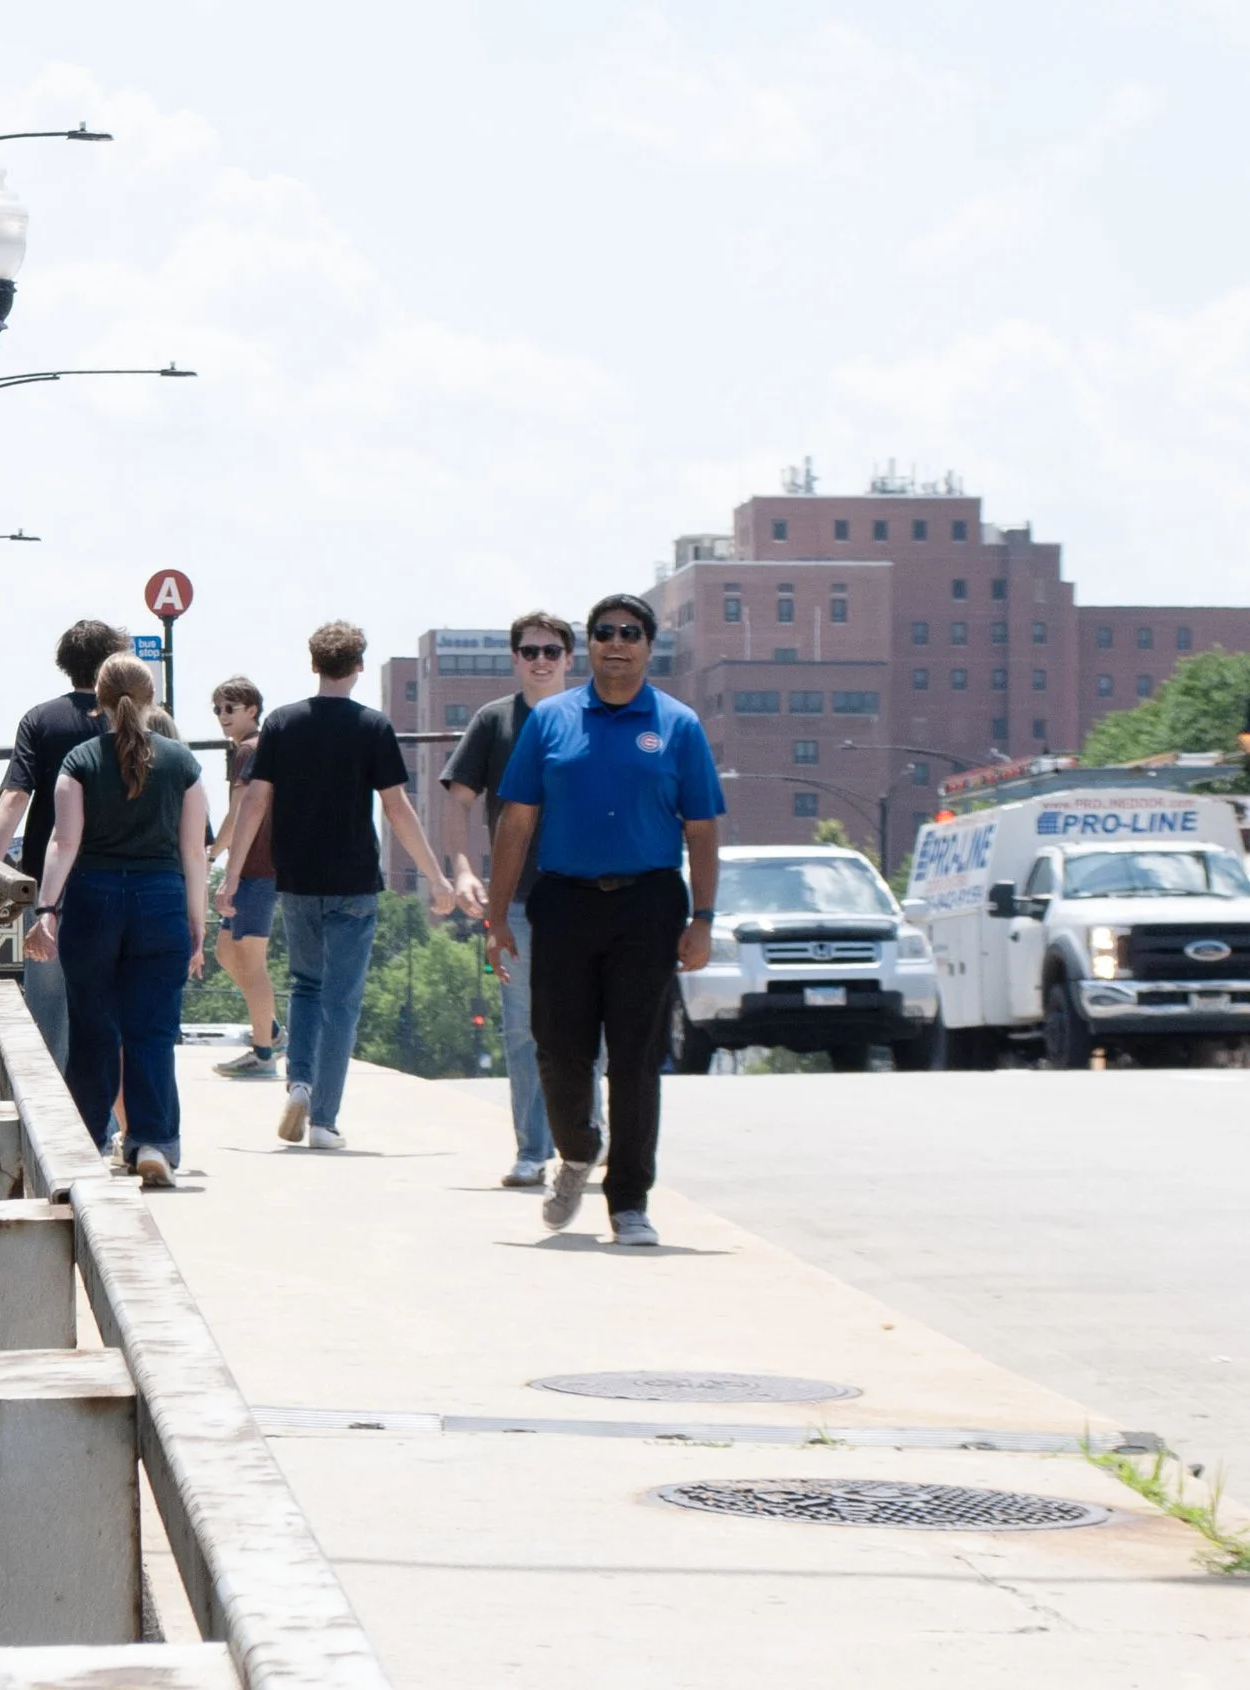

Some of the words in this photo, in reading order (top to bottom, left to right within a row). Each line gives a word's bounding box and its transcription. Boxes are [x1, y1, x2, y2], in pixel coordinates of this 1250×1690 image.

[153, 576, 184, 610] A
[138, 638, 156, 648] bus
[138, 648, 160, 659] stop
[1062, 811, 1199, 835] PRO-LINE
